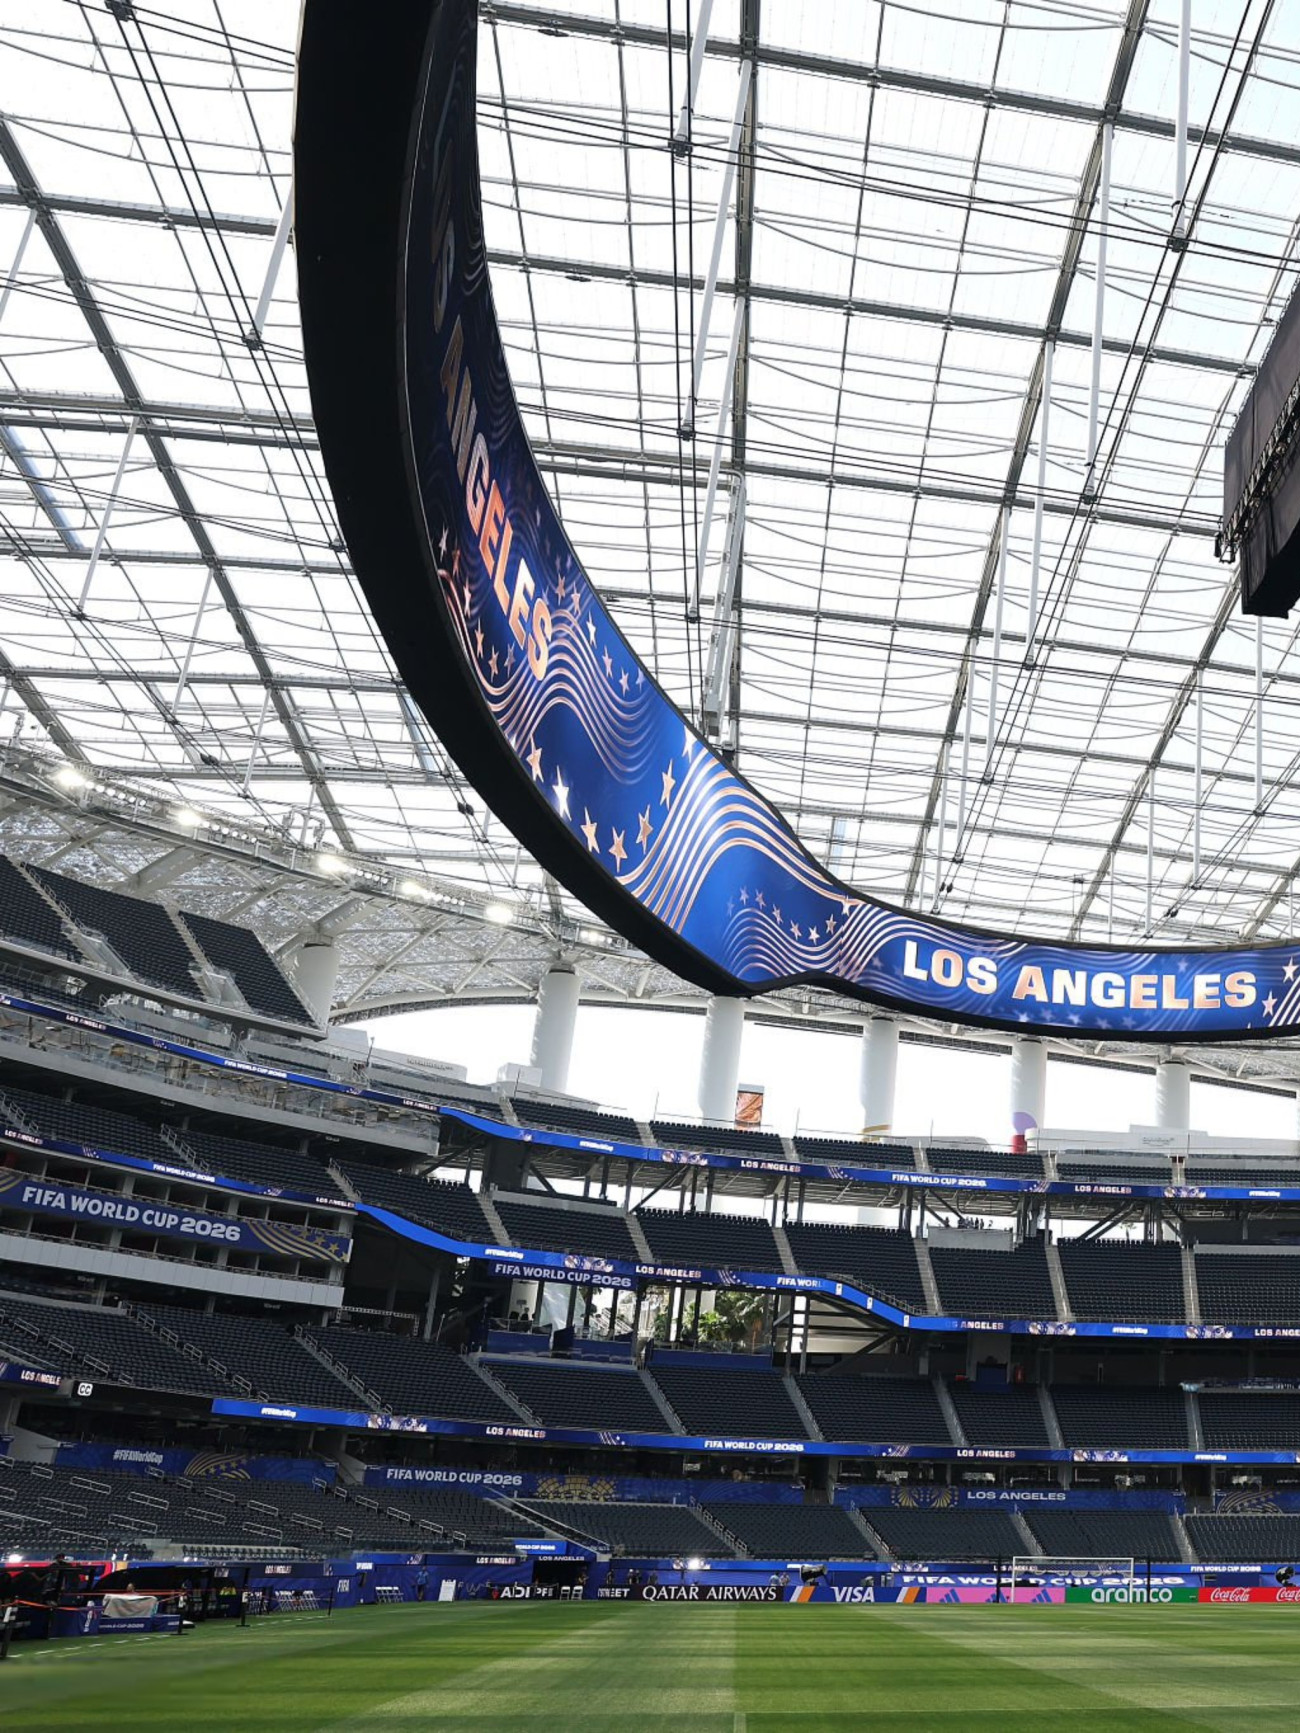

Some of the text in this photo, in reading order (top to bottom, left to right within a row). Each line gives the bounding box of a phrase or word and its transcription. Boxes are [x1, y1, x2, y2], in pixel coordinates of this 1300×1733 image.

[439, 314, 553, 682] ANGELES
[904, 939, 1258, 1010] LOS ANGELES
[741, 1160, 801, 1172] LOS ANGELES
[892, 1174, 910, 1182] FIFA
[911, 1175, 939, 1184] WORLD
[1093, 1186, 1132, 1194] ANGELES
[22, 1186, 241, 1242] FIFA WORLD CUP 2026
[495, 1263, 632, 1288] FIFA WORLD CUP 2026
[635, 1265, 702, 1279] LOS ANGELES
[777, 1277, 796, 1286] FIFA
[960, 1321, 1004, 1330] ANGELES
[1255, 1329, 1274, 1337] LOS
[79, 1385, 92, 1395] CC
[486, 1426, 546, 1439] LOS ANGELES
[704, 1440, 723, 1449] FIFA
[724, 1441, 755, 1450] WORLD
[756, 1442, 773, 1451] CUP
[113, 1449, 164, 1465] #FIFAWorldCup
[957, 1449, 1016, 1458] LOS ANGELES
[387, 1468, 523, 1486] FIFA WORLD CUP 2026
[967, 1490, 1066, 1501] LOS ANGELES
[902, 1575, 956, 1584] FIFA
[1051, 1577, 1098, 1586] CUP
[1101, 1575, 1185, 1586] 2026
[642, 1584, 700, 1601] QATAR
[706, 1584, 777, 1600] AIRWAYS
[831, 1587, 875, 1602] VISA
[1091, 1587, 1173, 1603] aramco
